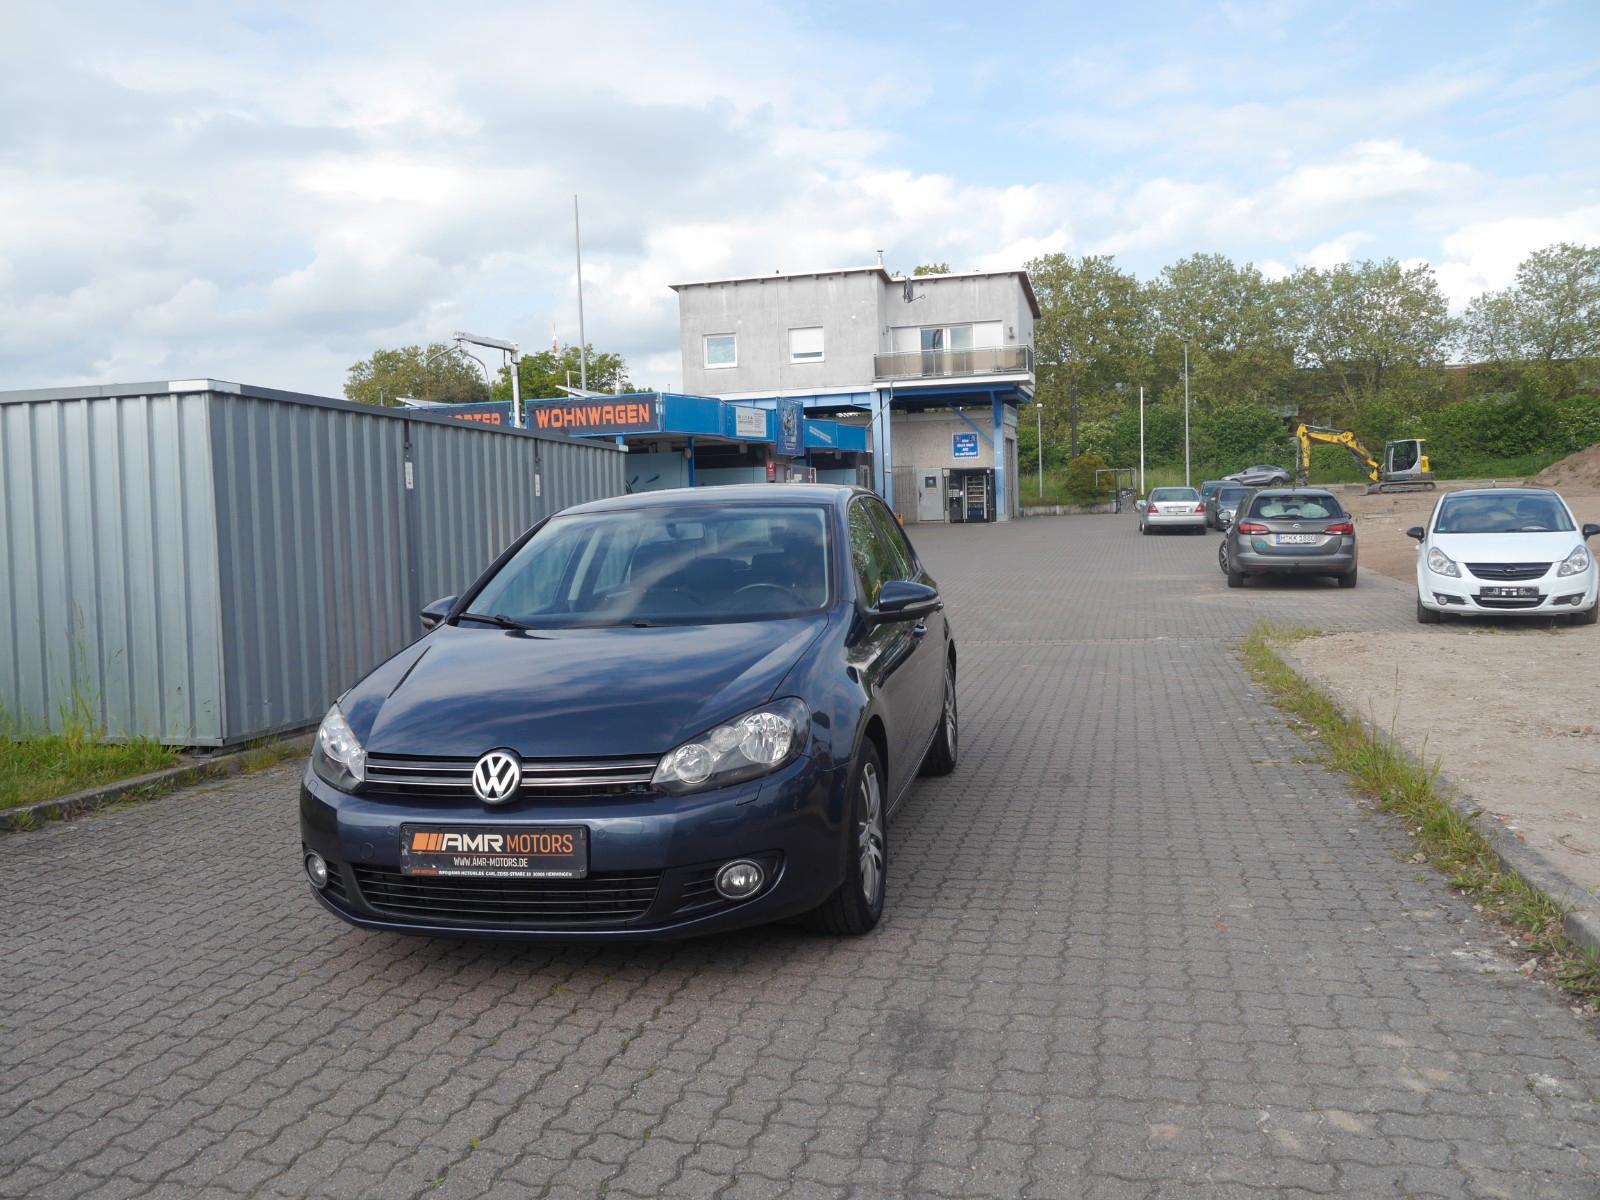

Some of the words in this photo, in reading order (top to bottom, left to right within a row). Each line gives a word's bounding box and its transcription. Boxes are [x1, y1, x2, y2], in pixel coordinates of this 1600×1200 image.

[536, 403, 650, 429] WOHNWAGEN
[474, 752, 520, 801] VW
[441, 833, 504, 852] AMR
[506, 834, 573, 853] MOTORS
[453, 857, 529, 868] WWW.AMR-MOTORS.DE
